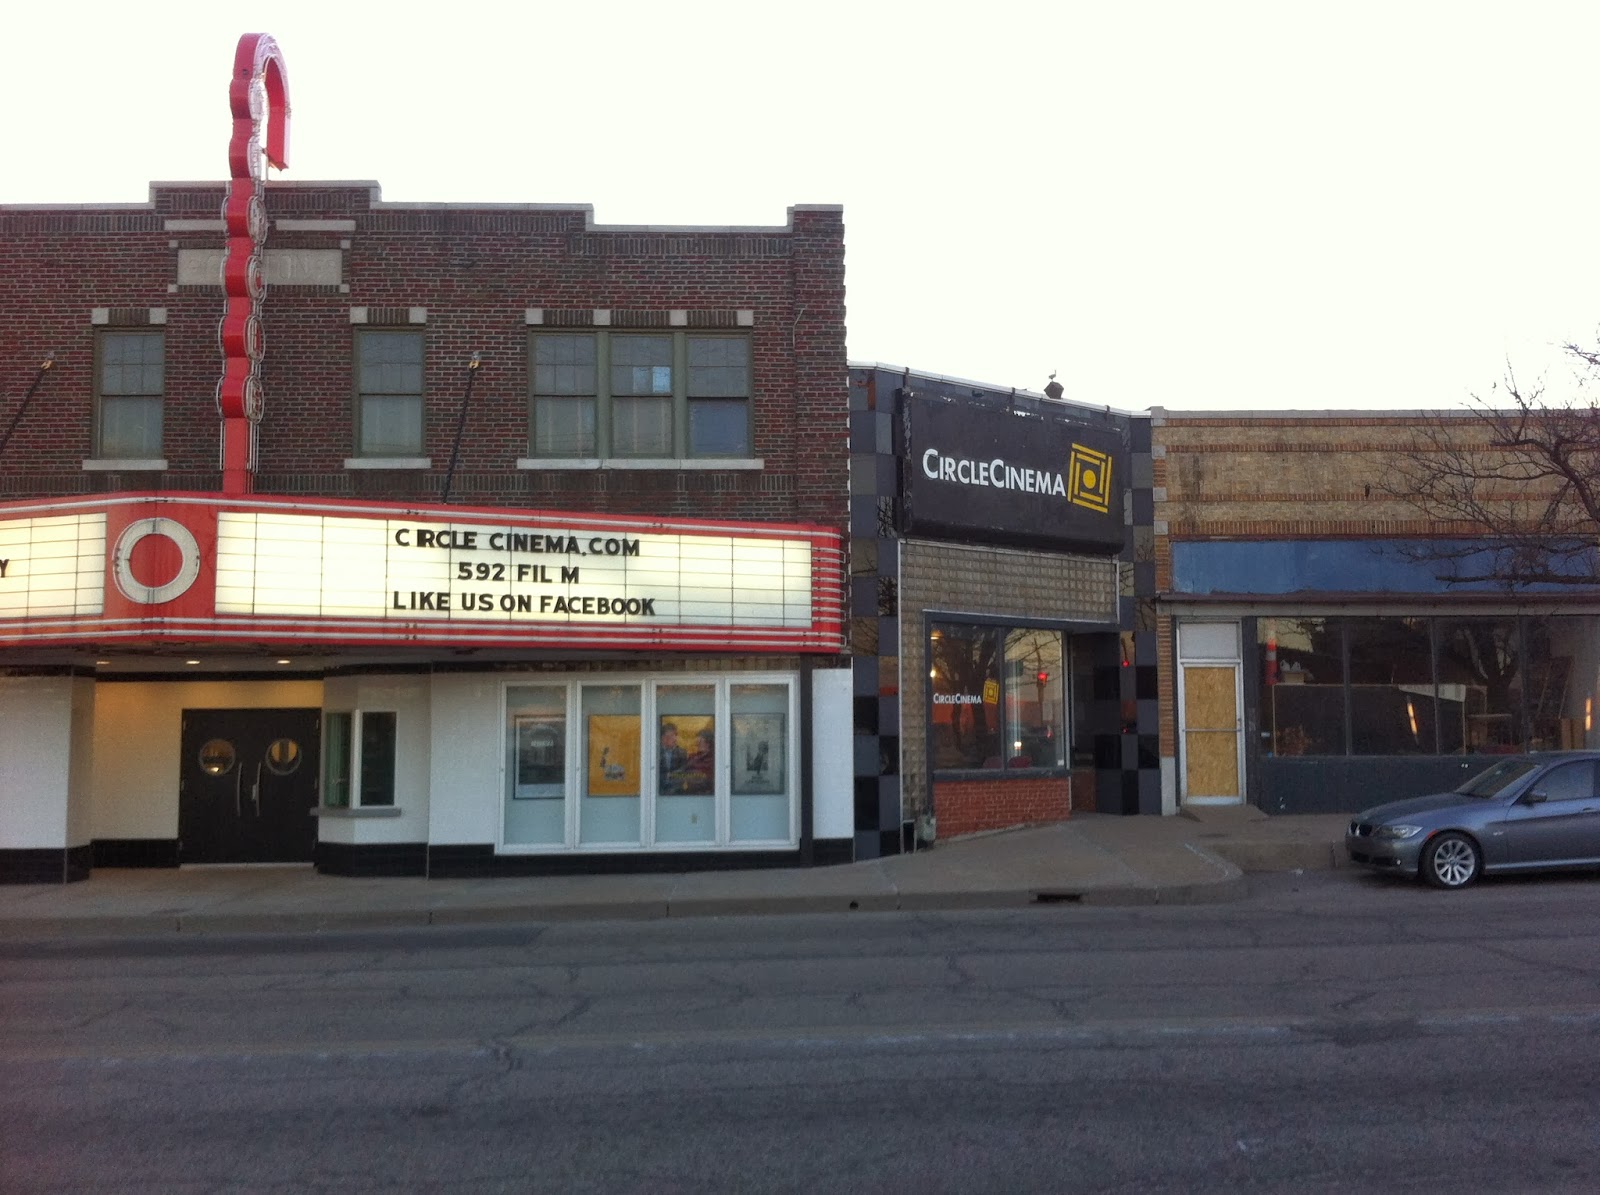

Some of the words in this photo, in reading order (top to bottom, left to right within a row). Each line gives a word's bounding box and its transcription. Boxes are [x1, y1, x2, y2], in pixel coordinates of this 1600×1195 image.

[489, 533, 640, 557] CINEMA.COM
[457, 562, 505, 581] 592
[517, 564, 580, 584] FILM
[393, 591, 450, 611] LIKE
[461, 592, 494, 611] US
[500, 594, 532, 613] ON
[540, 596, 656, 616] FACEBOOK
